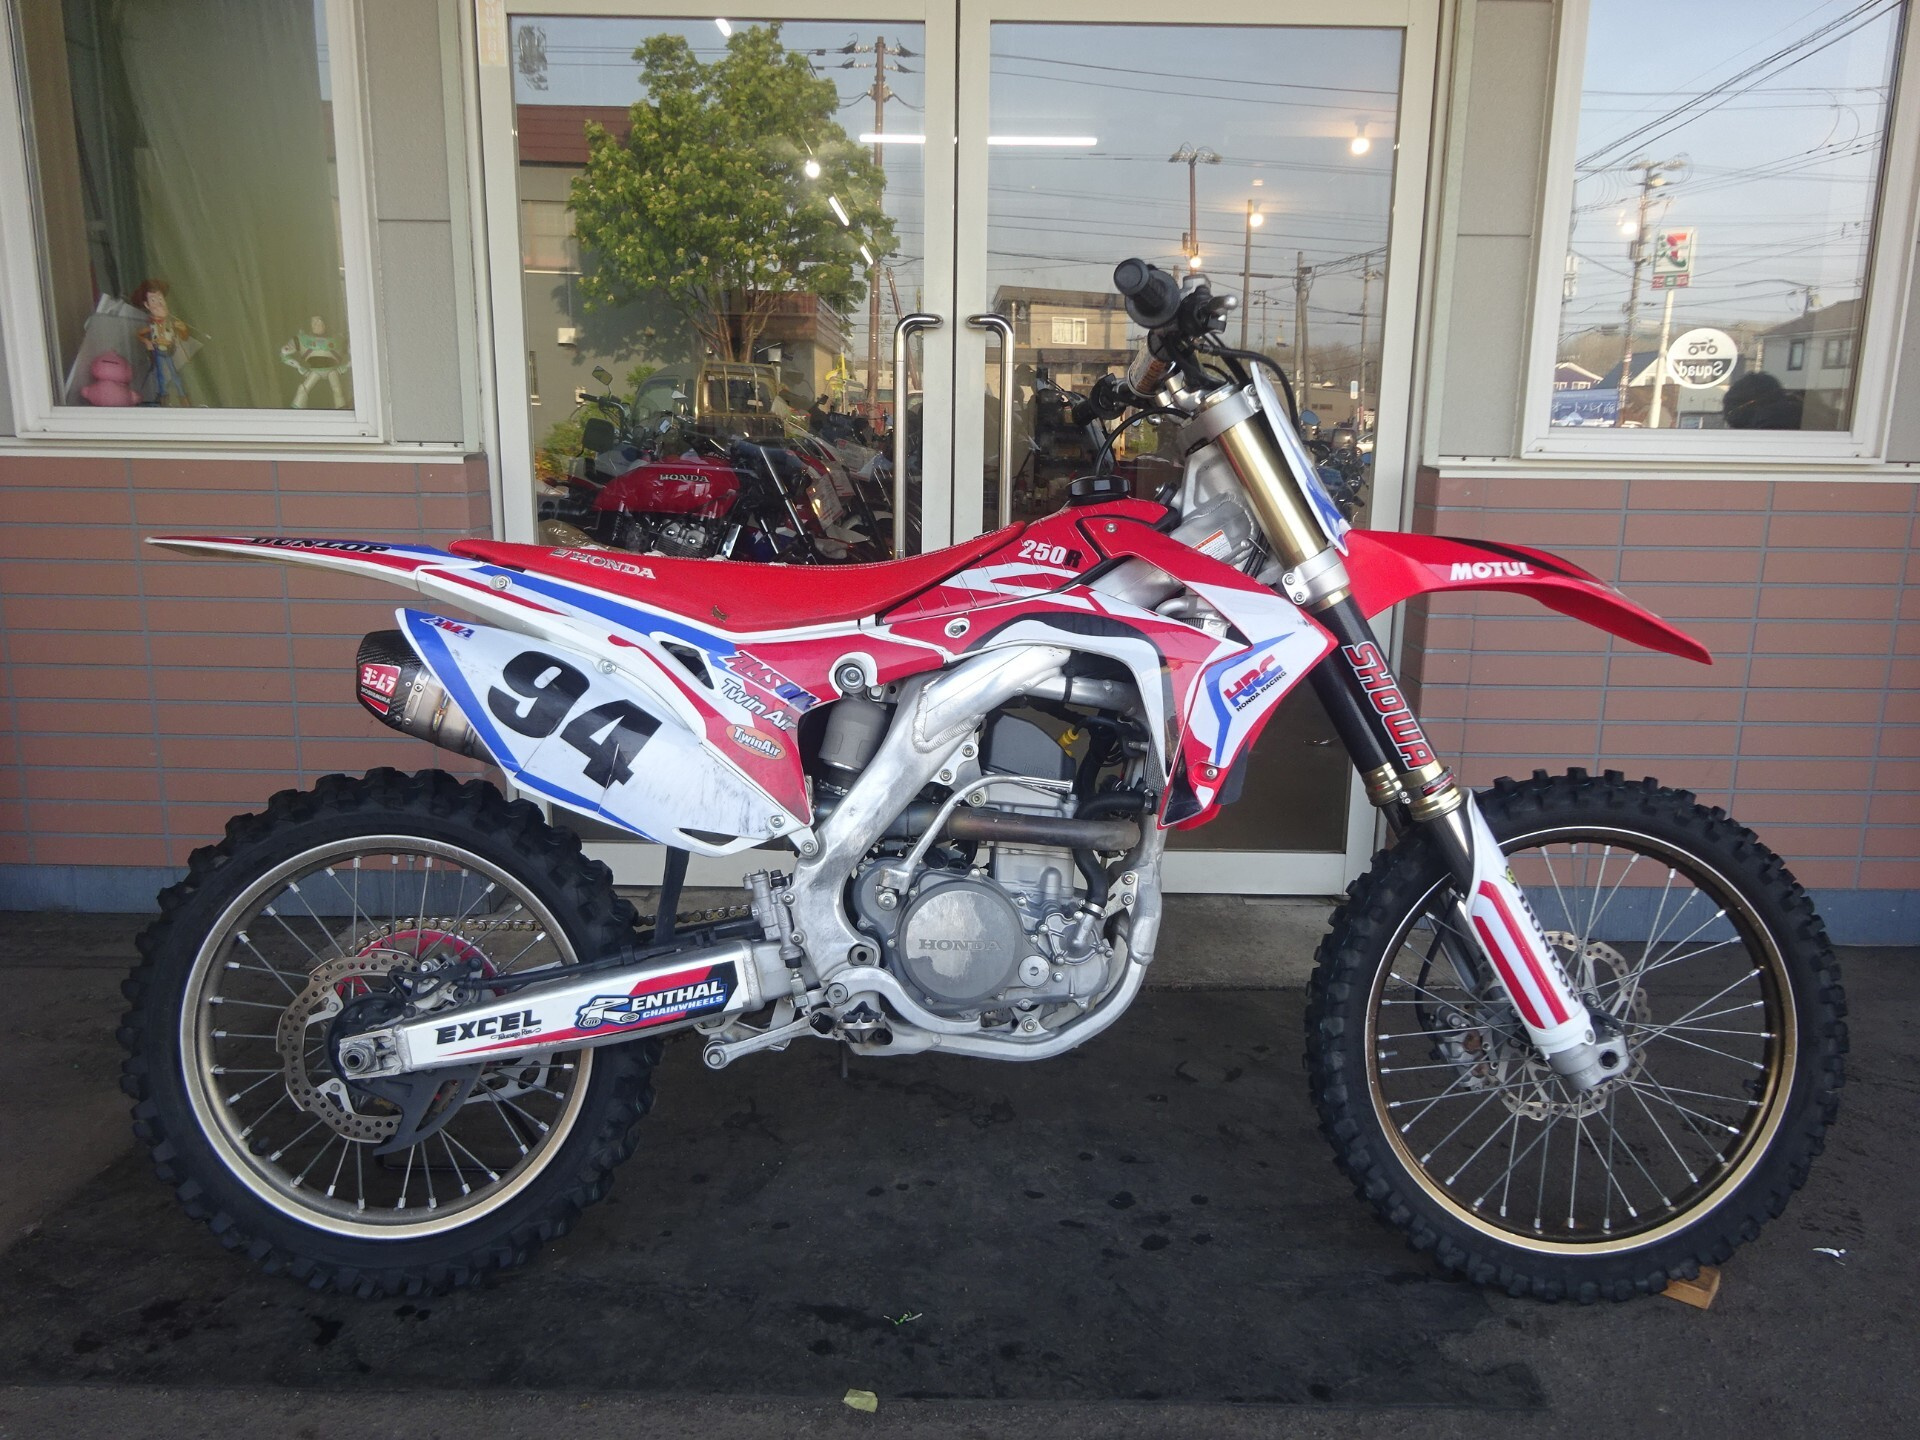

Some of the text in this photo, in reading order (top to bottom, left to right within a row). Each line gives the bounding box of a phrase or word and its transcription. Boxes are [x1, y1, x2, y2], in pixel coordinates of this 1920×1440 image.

[659, 473, 710, 483] HONDA
[248, 536, 391, 554] DUNLOP
[1017, 539, 1083, 569] 250R
[569, 551, 656, 579] HONDA
[1449, 561, 1535, 581] MOTUL
[421, 616, 476, 640] AMA
[362, 666, 397, 695] ヨシムラ
[1223, 654, 1284, 708] HRC
[1236, 670, 1287, 712] HONDA RACING
[721, 677, 797, 731] Twin Air
[1341, 641, 1437, 771] SHOWA
[488, 651, 662, 788] 94
[733, 726, 781, 758] TwinAir
[918, 938, 1003, 951] HONDA
[642, 995, 725, 1019] CHAINWHEELS
[435, 1010, 542, 1045] EXCEL
